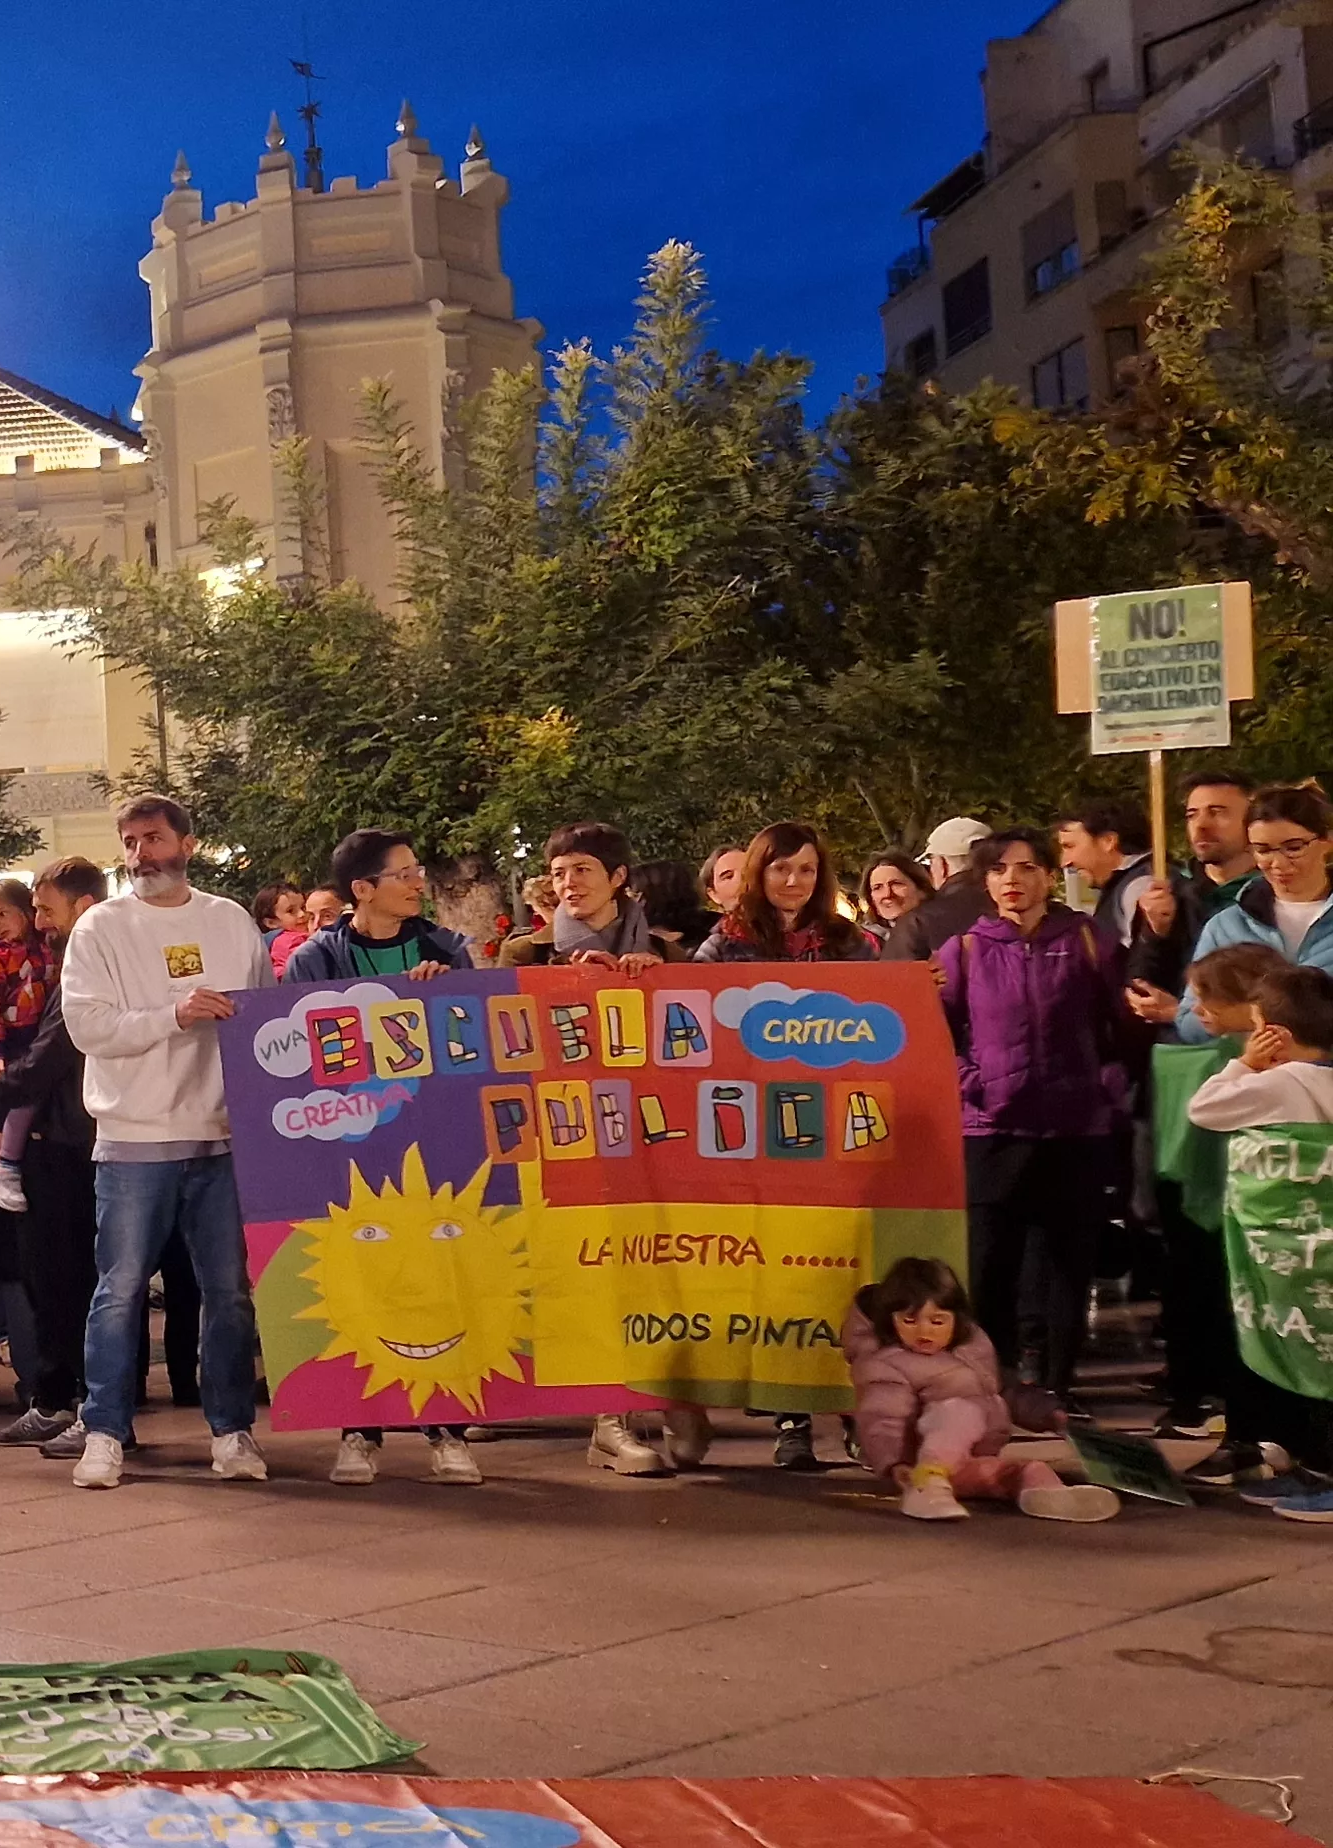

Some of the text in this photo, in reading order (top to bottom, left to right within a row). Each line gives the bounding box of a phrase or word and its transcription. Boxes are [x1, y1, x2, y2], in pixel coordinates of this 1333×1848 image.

[1128, 598, 1186, 641] NO!
[1100, 649, 1119, 669] AL
[1100, 663, 1221, 691] EDUCATIVO EN
[259, 1029, 309, 1061] VIVA
[312, 1002, 708, 1076] ESCUELA
[762, 1014, 876, 1045] CRÍTICA
[578, 1235, 615, 1266] LA
[621, 1233, 766, 1266] NUESTRA
[620, 1312, 845, 1349] TODOS PINTA
